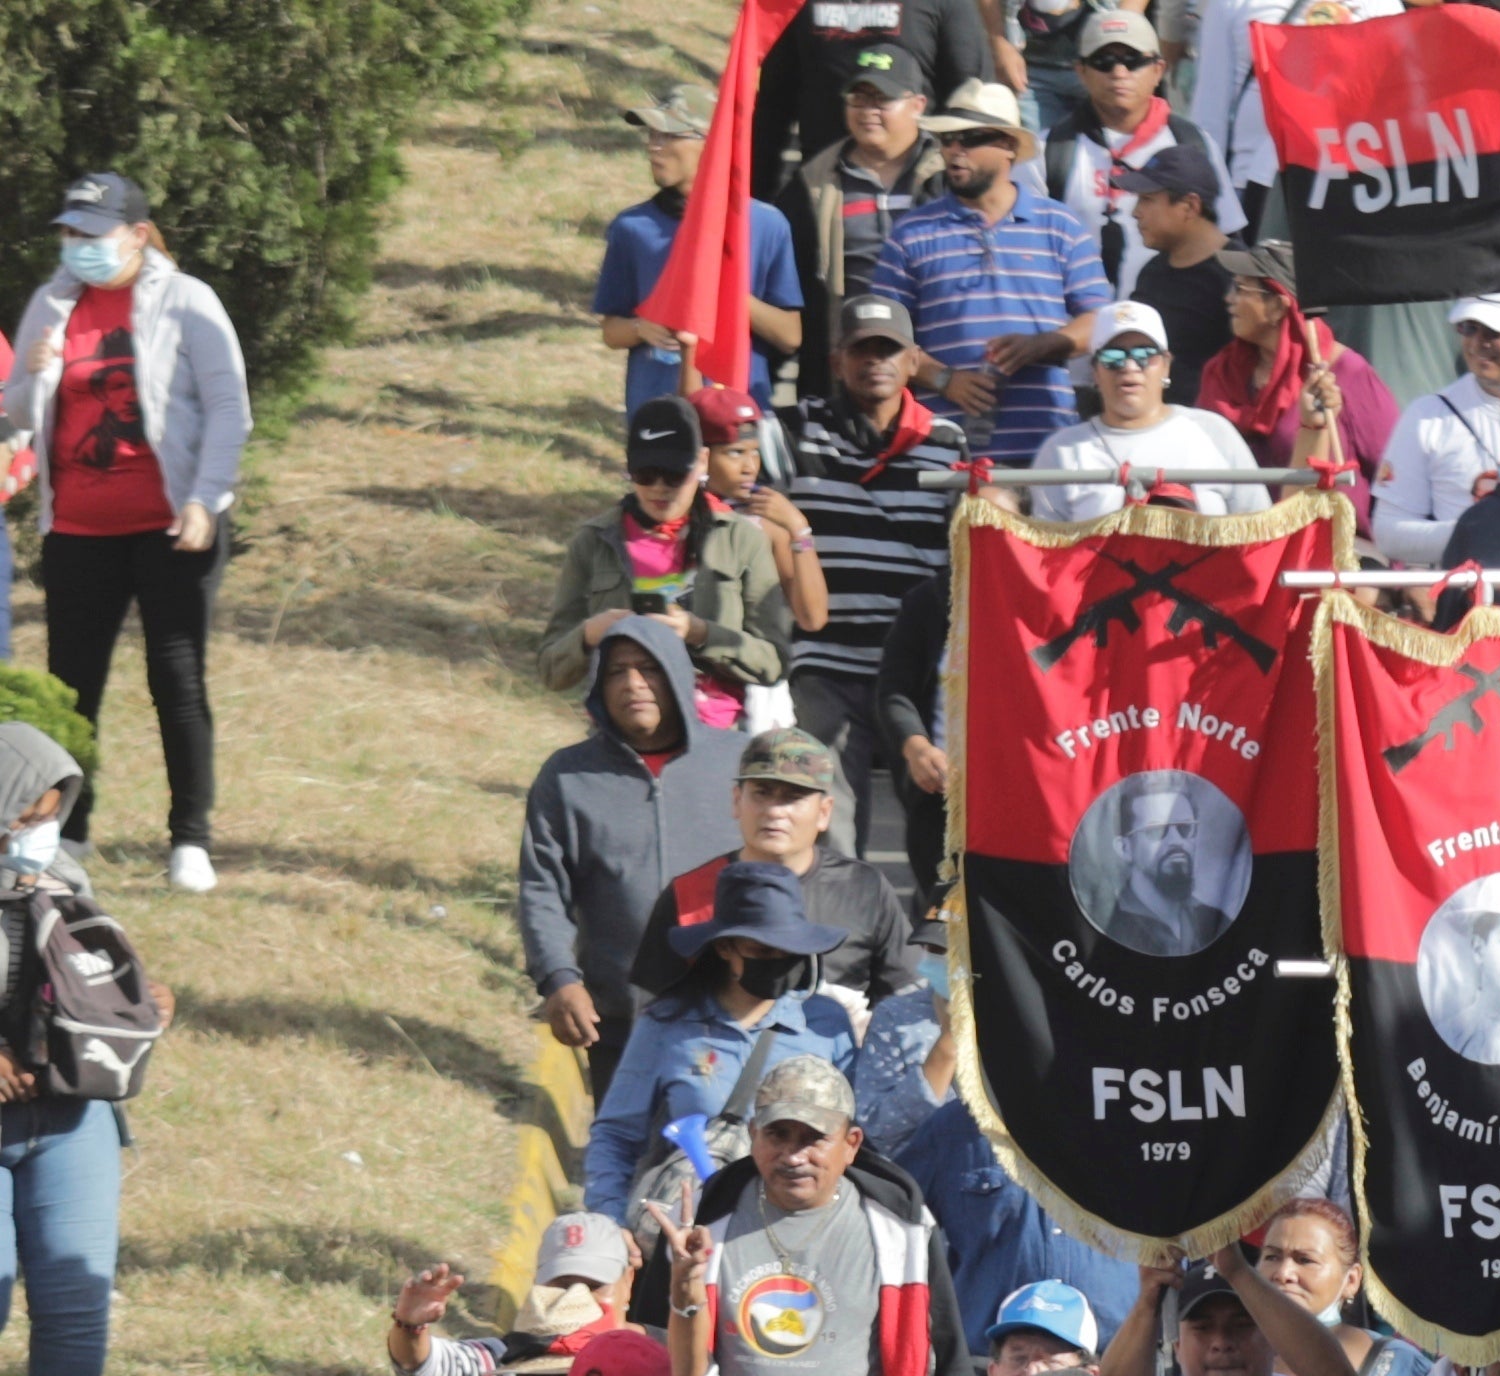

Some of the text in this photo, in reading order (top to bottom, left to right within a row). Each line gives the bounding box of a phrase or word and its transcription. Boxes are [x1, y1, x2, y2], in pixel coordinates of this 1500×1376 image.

[1307, 107, 1481, 214] FSLN
[1054, 700, 1262, 763] Frente Norte
[1050, 937, 1271, 1023] Carlos Fonseca
[1090, 1064, 1249, 1124] FSLN
[1138, 1139, 1192, 1164] 1979
